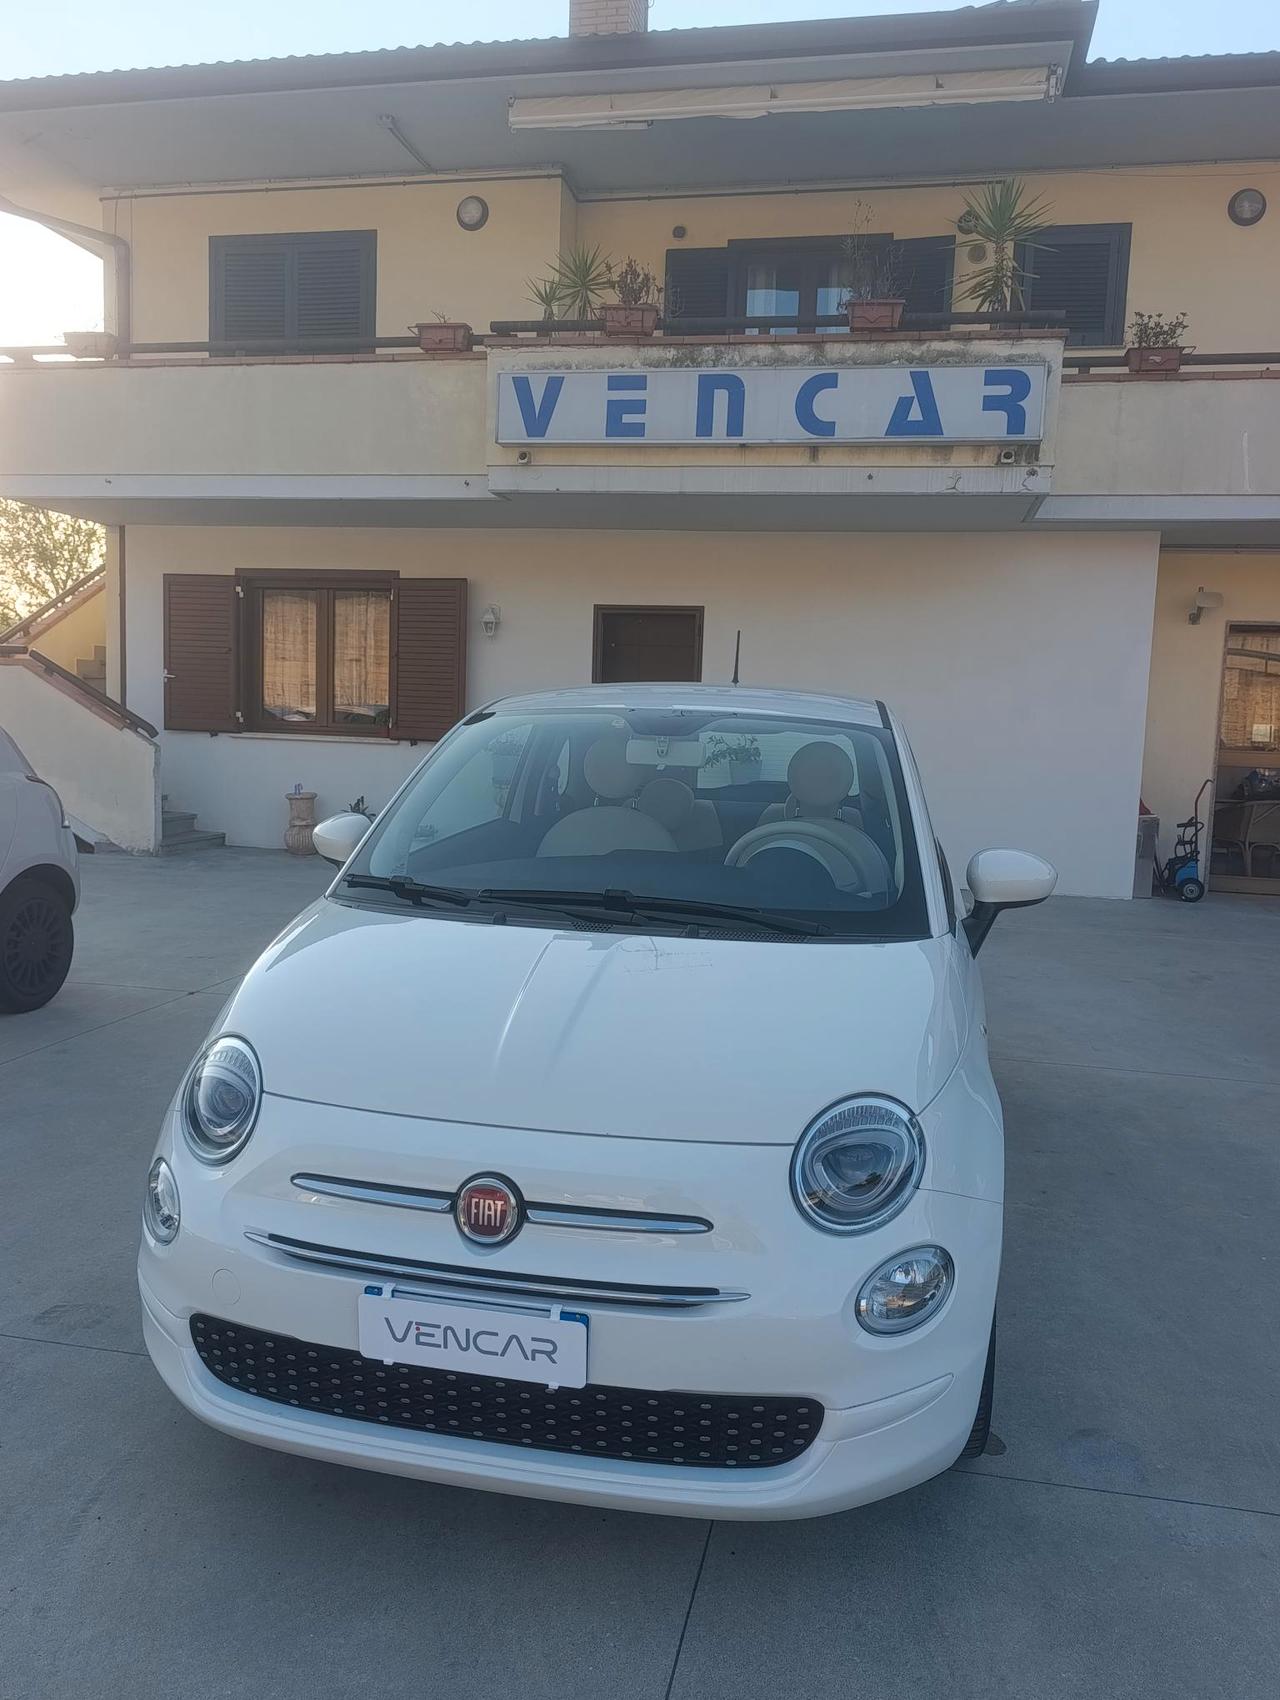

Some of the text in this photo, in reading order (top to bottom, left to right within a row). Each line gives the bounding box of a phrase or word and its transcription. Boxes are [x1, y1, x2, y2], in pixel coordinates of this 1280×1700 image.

[512, 369, 1031, 438] VENCAR
[470, 1197, 505, 1227] FIAT
[384, 1316, 559, 1365] VENCAR
